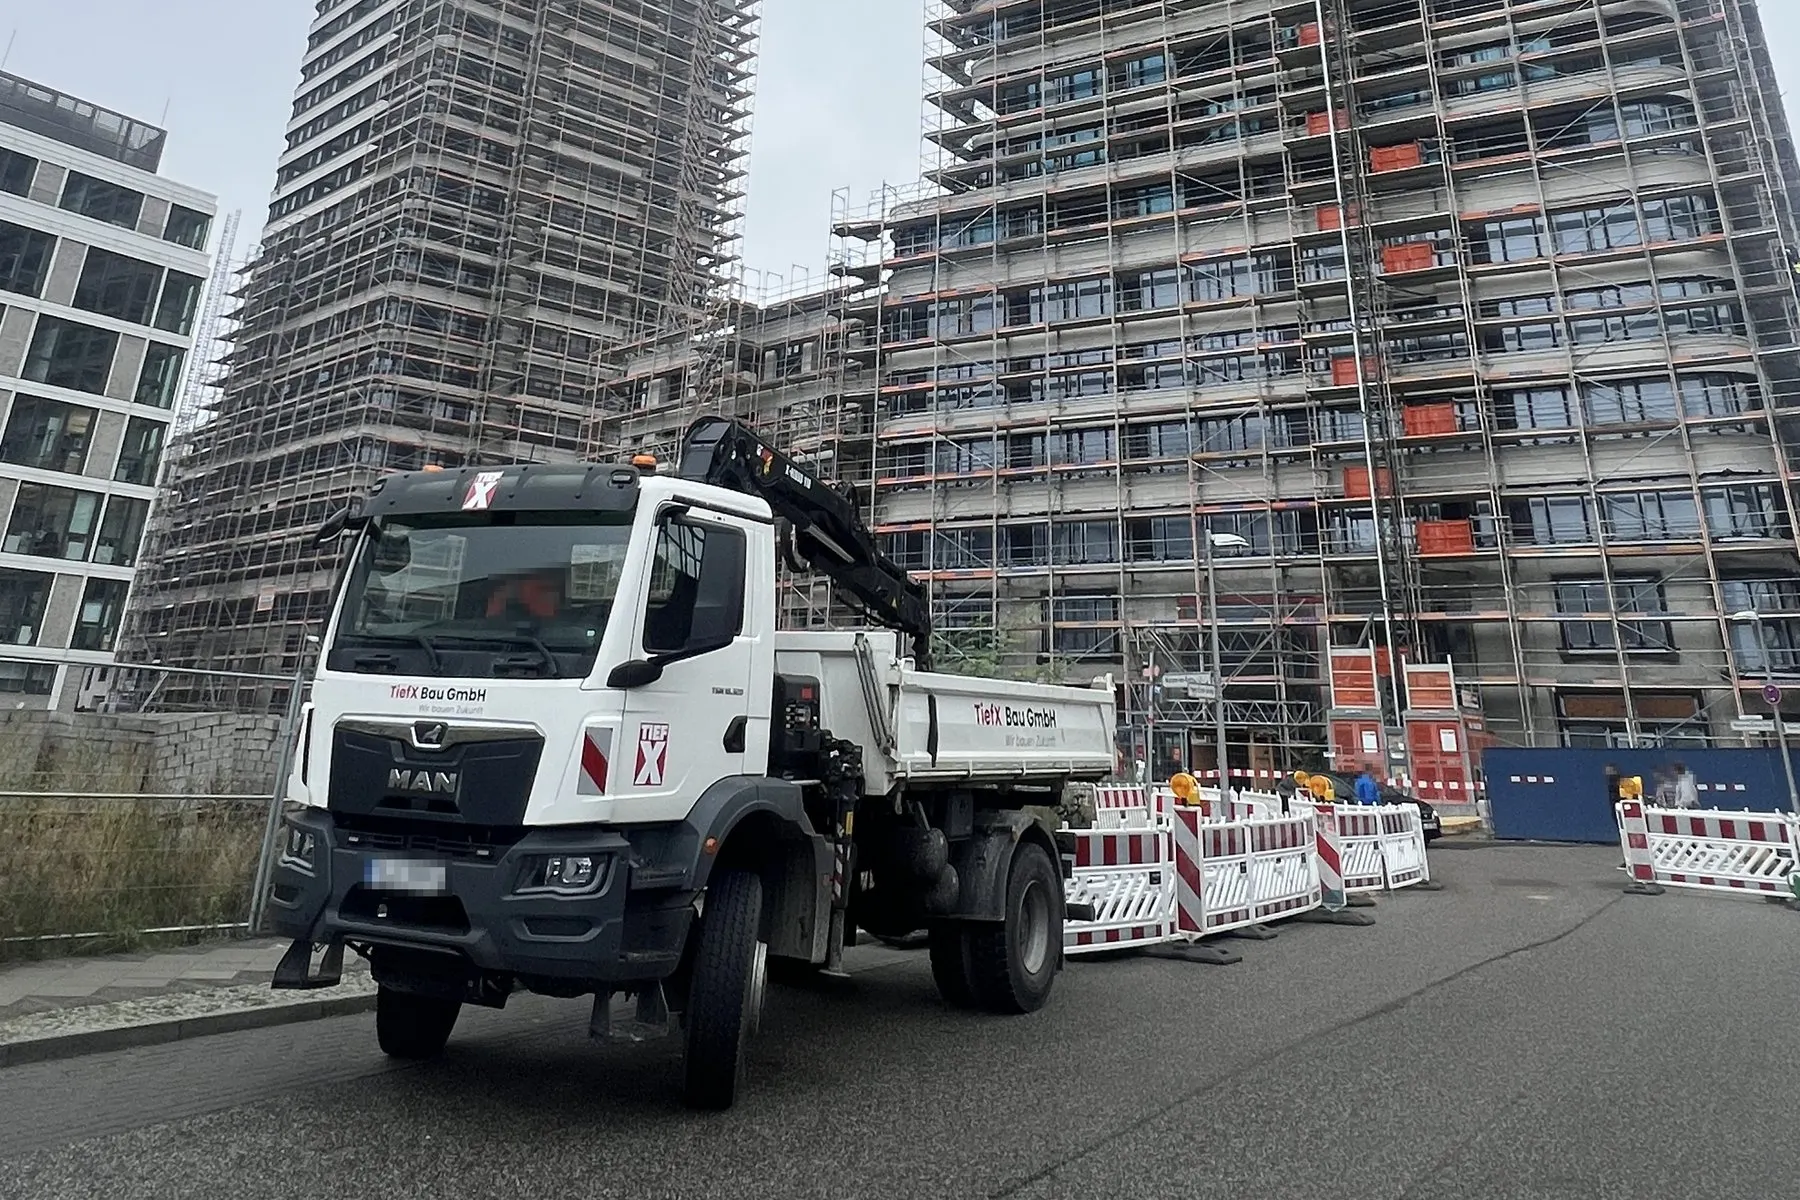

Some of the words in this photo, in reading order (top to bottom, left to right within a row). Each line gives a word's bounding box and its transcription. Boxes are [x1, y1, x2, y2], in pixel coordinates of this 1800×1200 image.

[461, 481, 498, 510] X
[390, 684, 419, 699] TiefX
[420, 686, 444, 700] Bau
[446, 687, 487, 702] GmbH
[431, 705, 455, 713] bauen
[974, 702, 1003, 726] TiefX
[1005, 706, 1025, 727] Bau
[1026, 707, 1057, 728] GmbH
[641, 724, 669, 741] TIEF
[634, 740, 667, 785] X
[387, 768, 457, 793] MAN
